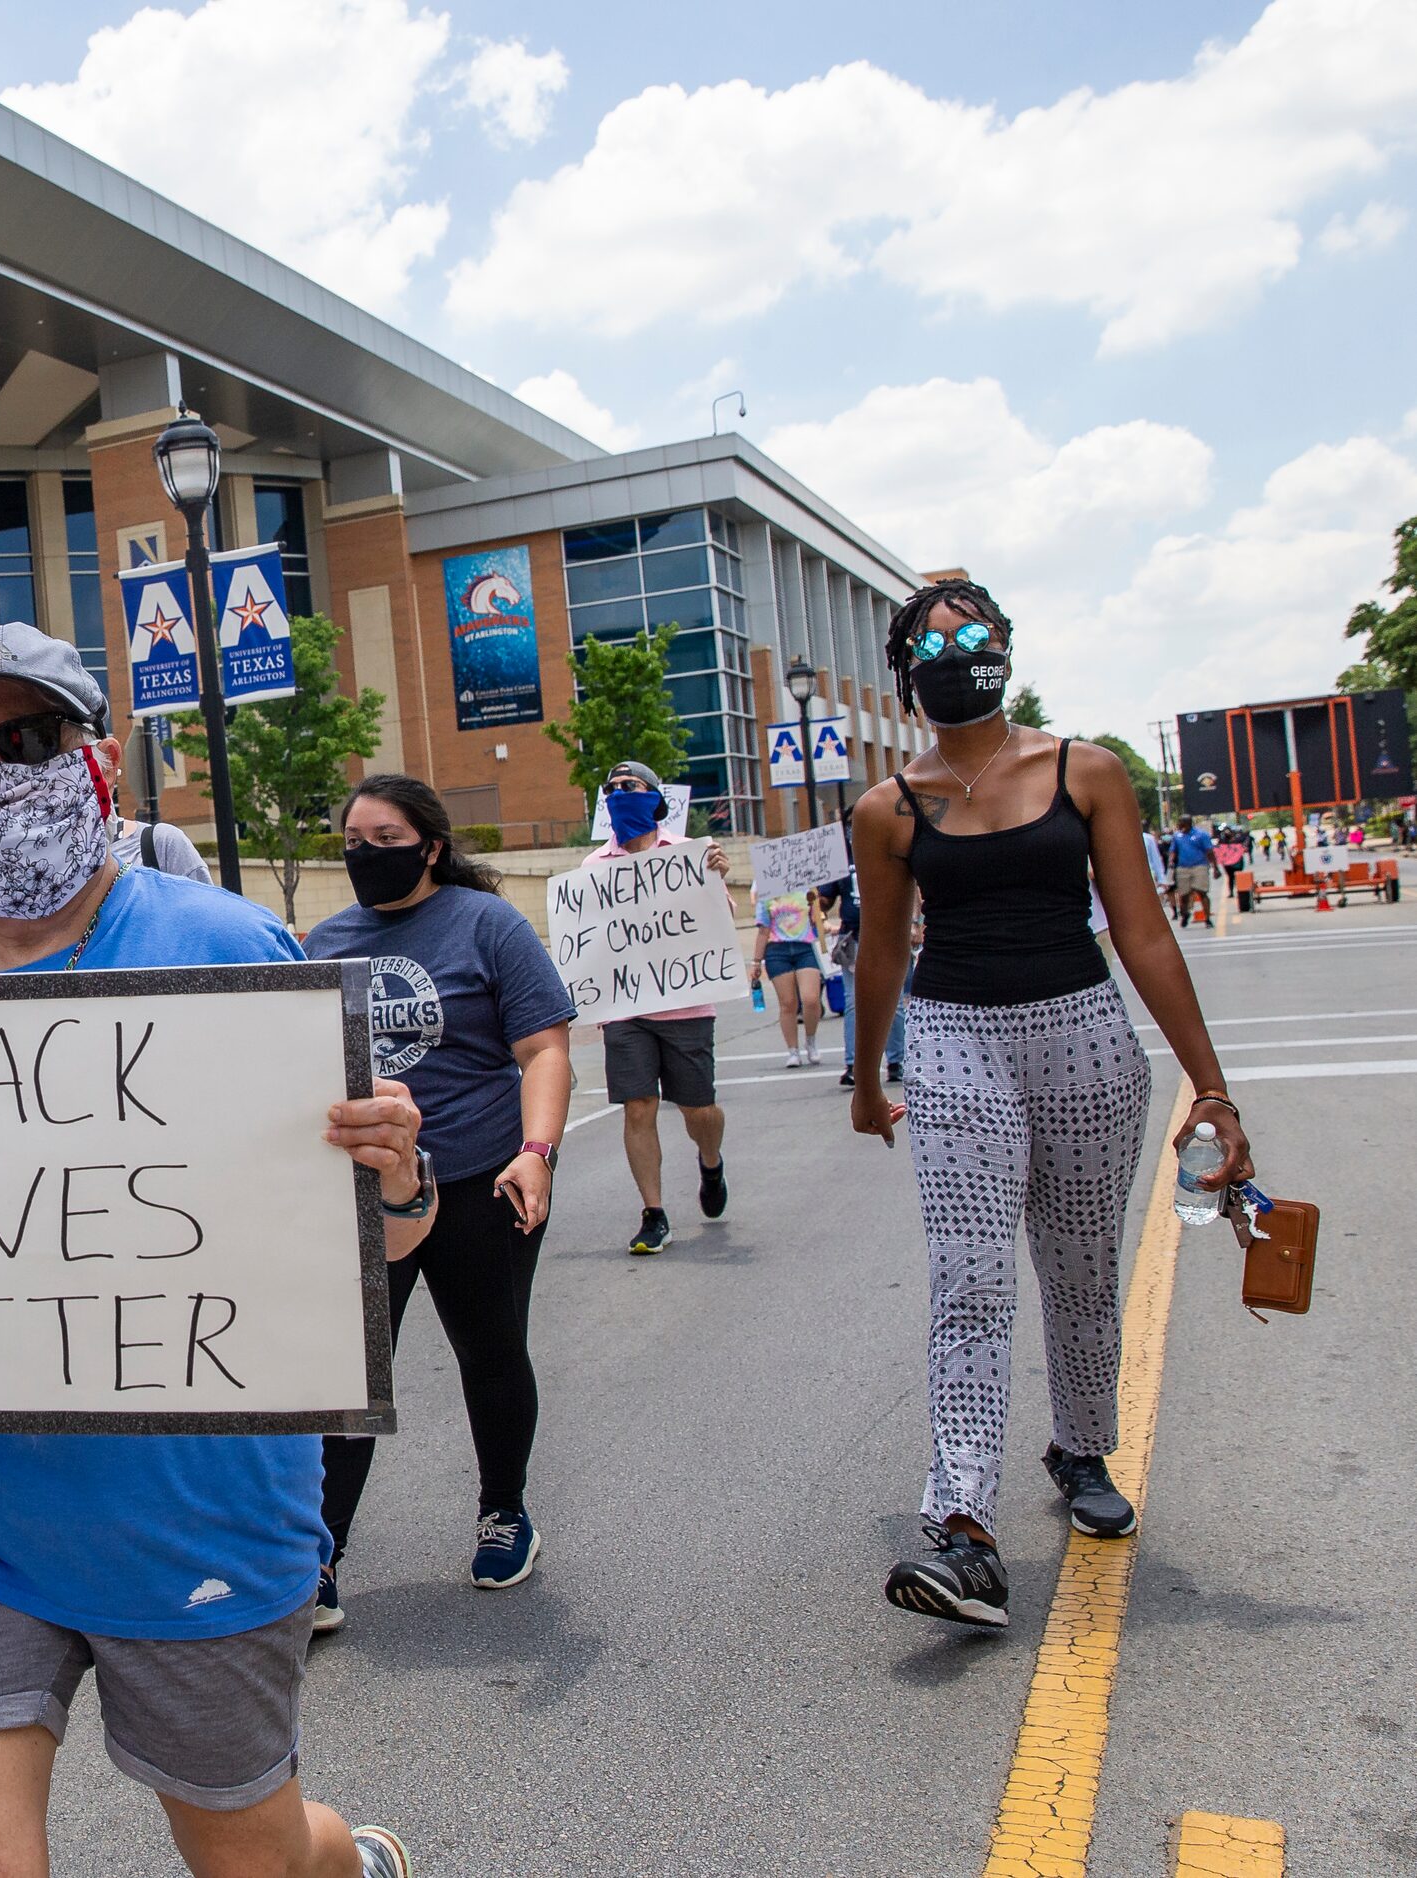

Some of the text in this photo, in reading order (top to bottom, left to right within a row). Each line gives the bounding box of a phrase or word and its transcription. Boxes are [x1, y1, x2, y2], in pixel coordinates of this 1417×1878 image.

[229, 644, 283, 659] UNIVERSITY OF
[139, 661, 180, 674] UNIVERSITY
[230, 654, 285, 675] TEXAS
[971, 665, 1005, 677] GEORGE
[140, 669, 192, 689] TEXAS
[232, 670, 286, 687] ARLINGTON
[975, 678, 1002, 690] FLOYD
[140, 685, 193, 700] ARLINGTON
[589, 848, 711, 909] WEAPON
[559, 926, 597, 966] OF
[373, 958, 420, 980] VERSITY
[647, 946, 738, 997] VOICE
[373, 1000, 439, 1030] RICKS
